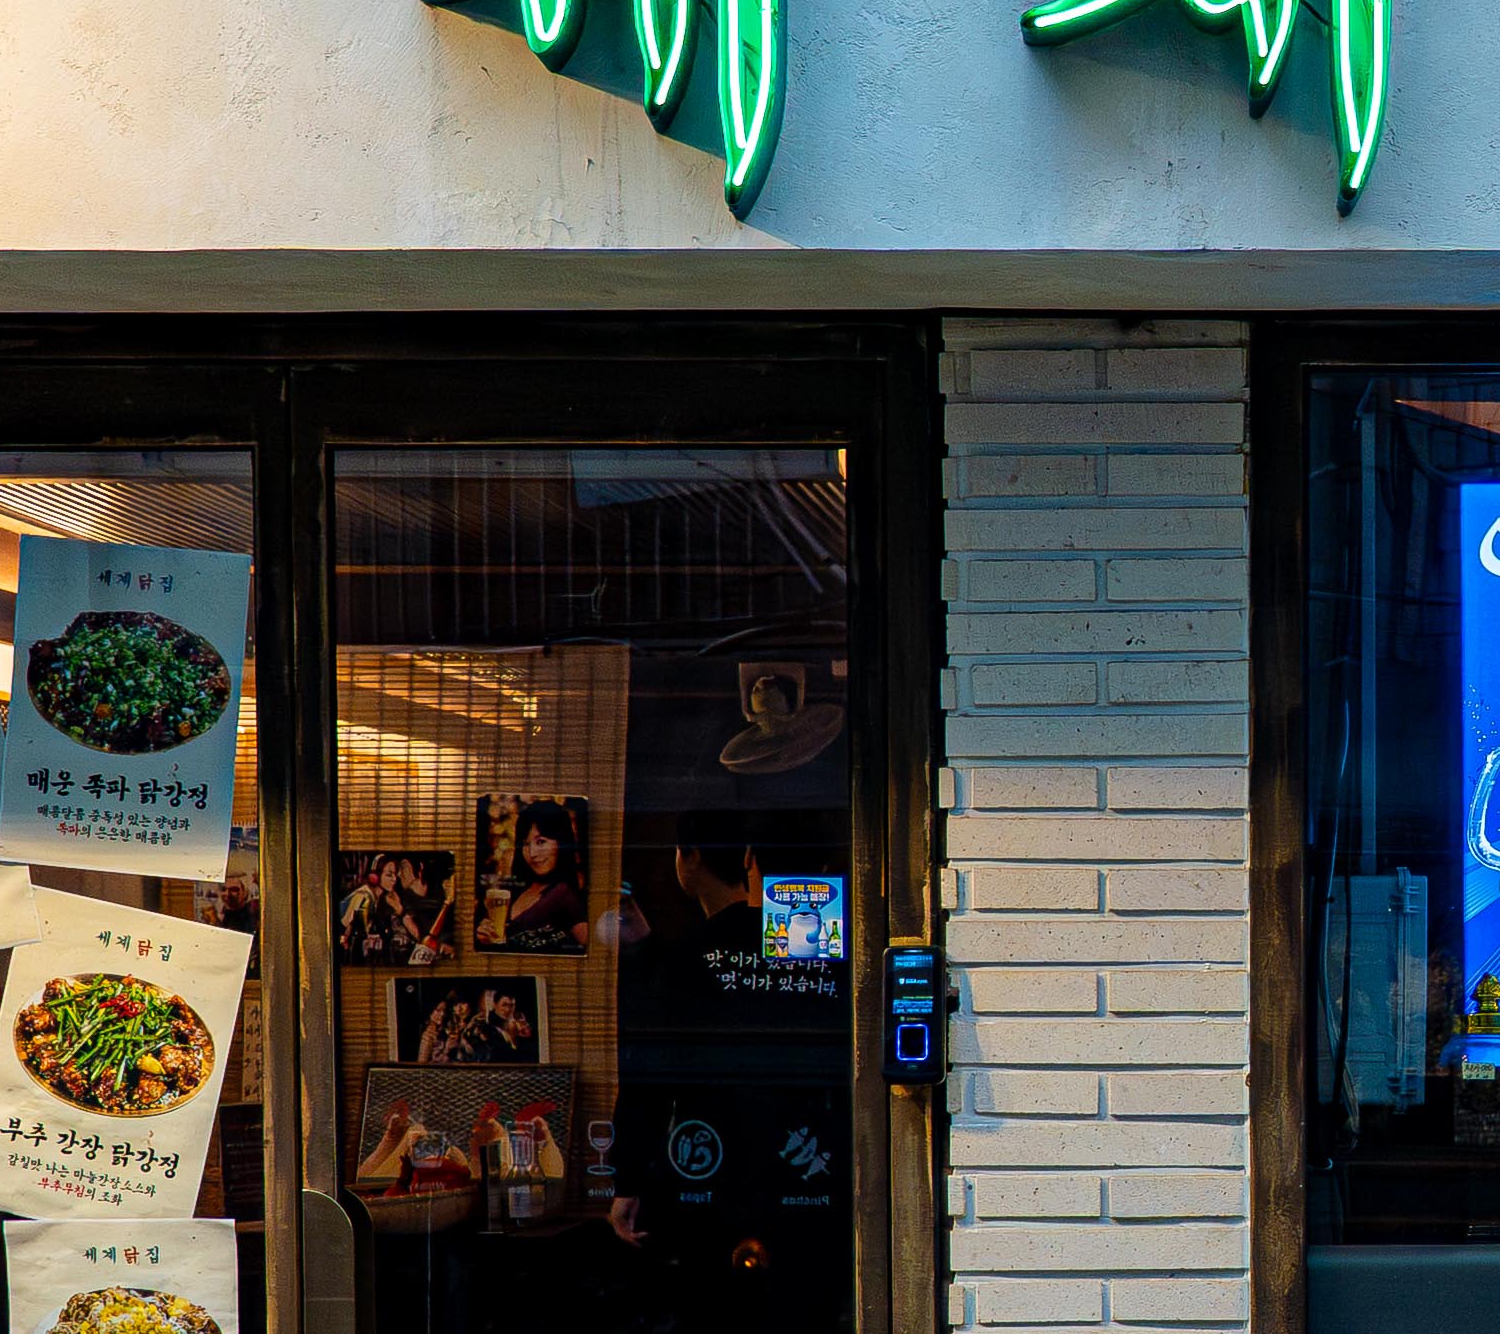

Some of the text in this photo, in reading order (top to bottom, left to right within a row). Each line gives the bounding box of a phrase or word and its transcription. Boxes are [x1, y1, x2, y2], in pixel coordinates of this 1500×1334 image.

[26, 768, 208, 809] 매운 쪽파 닭강정
[127, 813, 151, 827] 있는
[0, 1118, 180, 1178] 부추 간장 닭강정
[8, 1154, 42, 1173] 감칠맛
[46, 1162, 70, 1178] 나는
[38, 1178, 123, 1206] 부추무침의 조화
